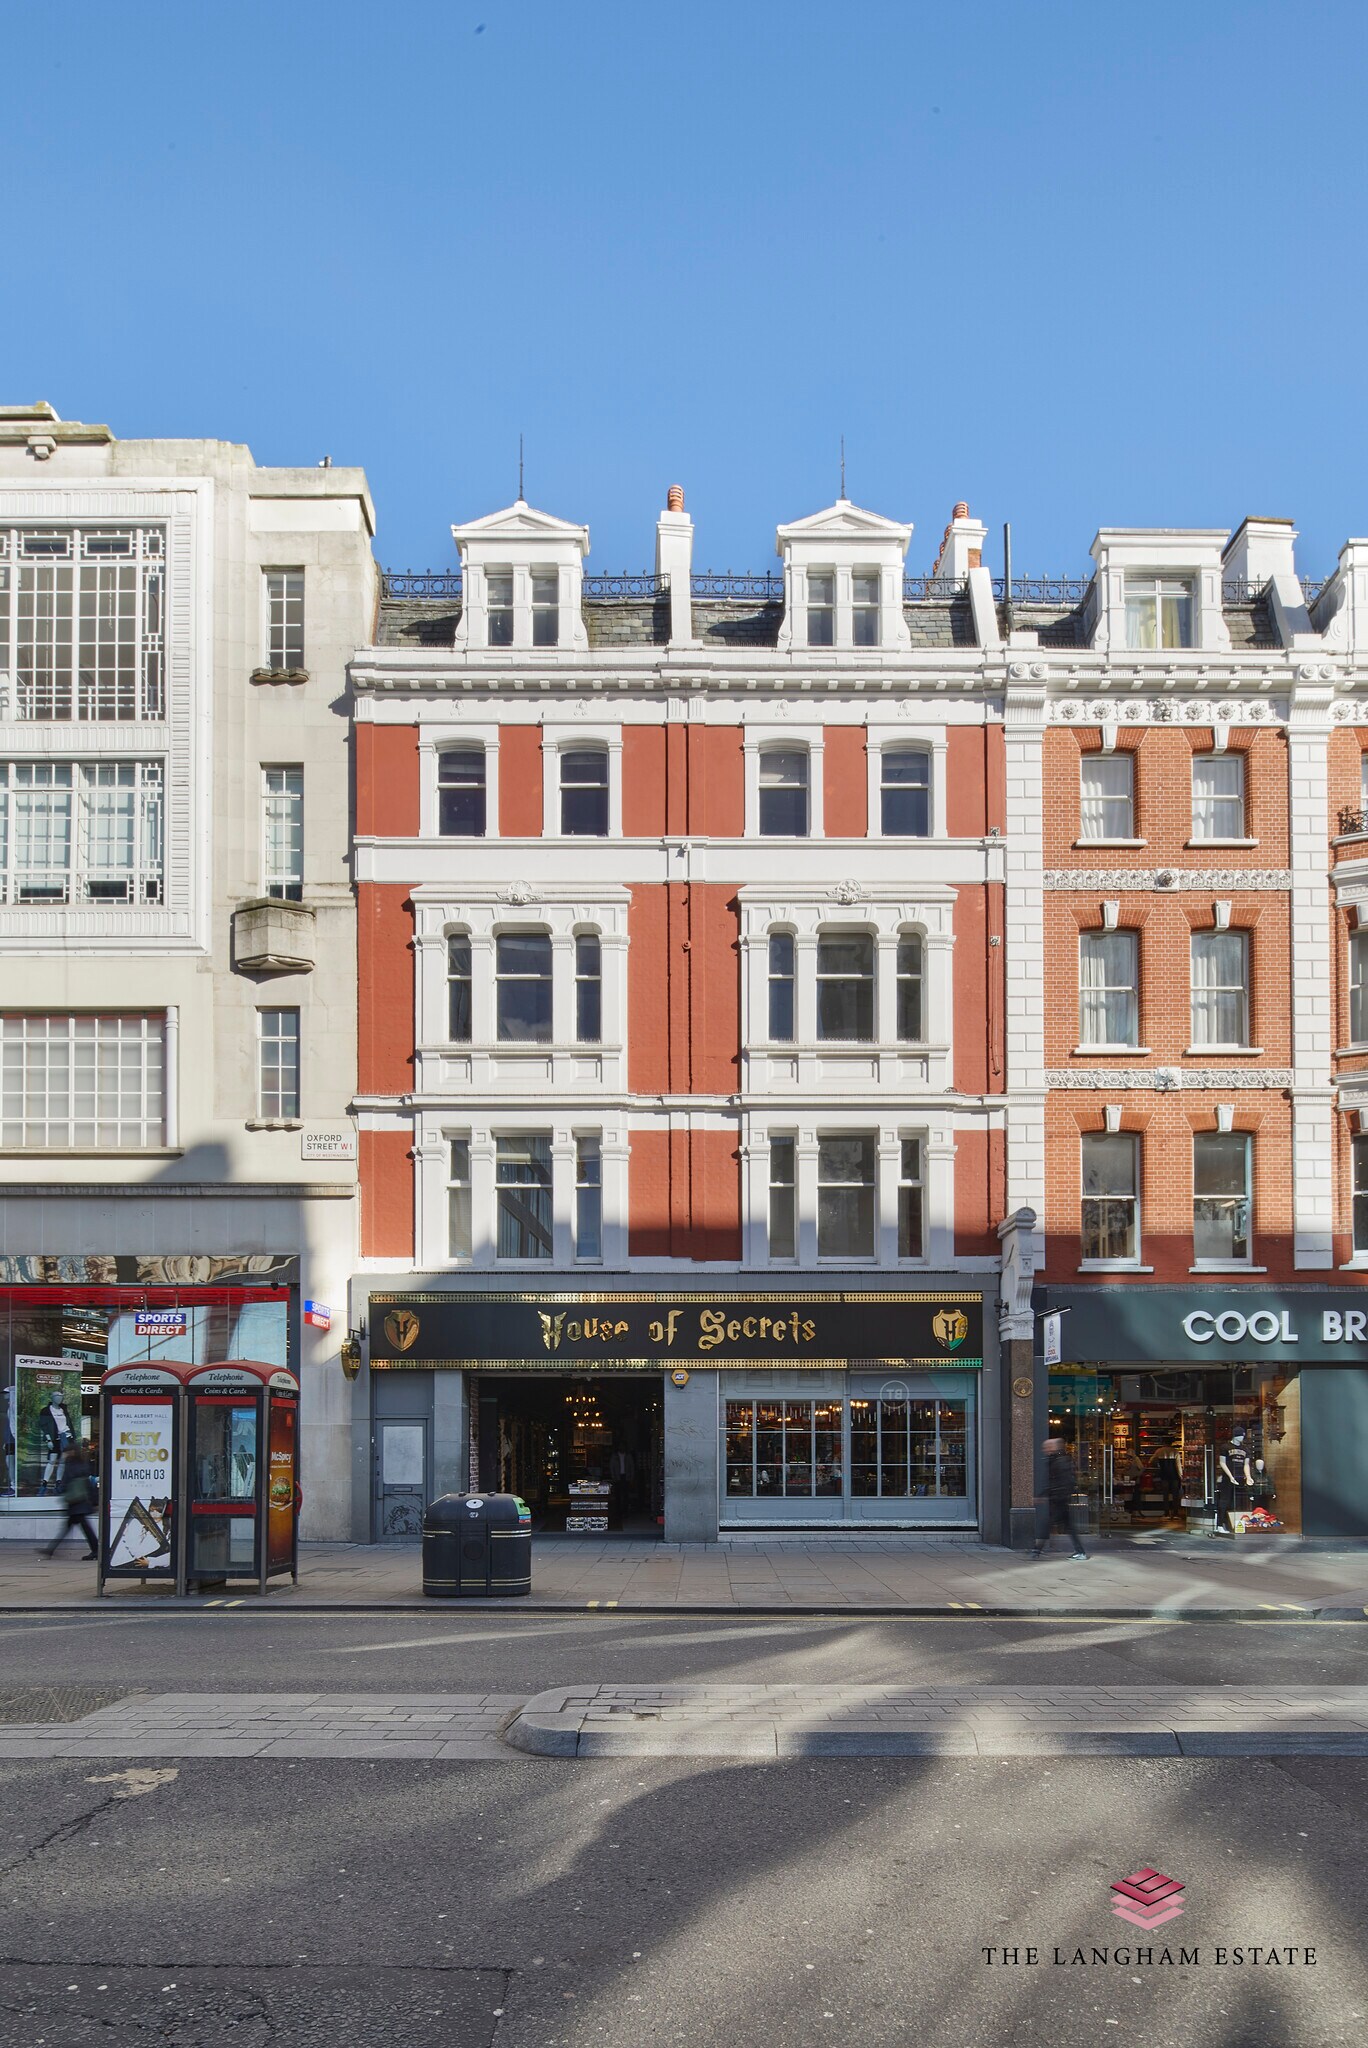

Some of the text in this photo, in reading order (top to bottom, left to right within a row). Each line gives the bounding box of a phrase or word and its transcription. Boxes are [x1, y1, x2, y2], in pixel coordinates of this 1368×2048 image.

[311, 1302, 330, 1316] SPORTS
[138, 1313, 183, 1323] SPORTS
[311, 1315, 330, 1328] DIRECT
[138, 1325, 182, 1334] DIRECT
[537, 1309, 817, 1351] House of Secrets
[1183, 1310, 1299, 1343] COOL
[71, 1350, 89, 1361] RUN
[19, 1358, 63, 1367] OFF-ROAD
[125, 1373, 160, 1382] Telephone
[209, 1373, 244, 1382] Telephone
[204, 1387, 248, 1395] Coins & Cards
[120, 1431, 161, 1445] KETY
[115, 1448, 169, 1462] FUSCO
[271, 1451, 292, 1463] McSpicy
[120, 1469, 165, 1480] MARCH 03
